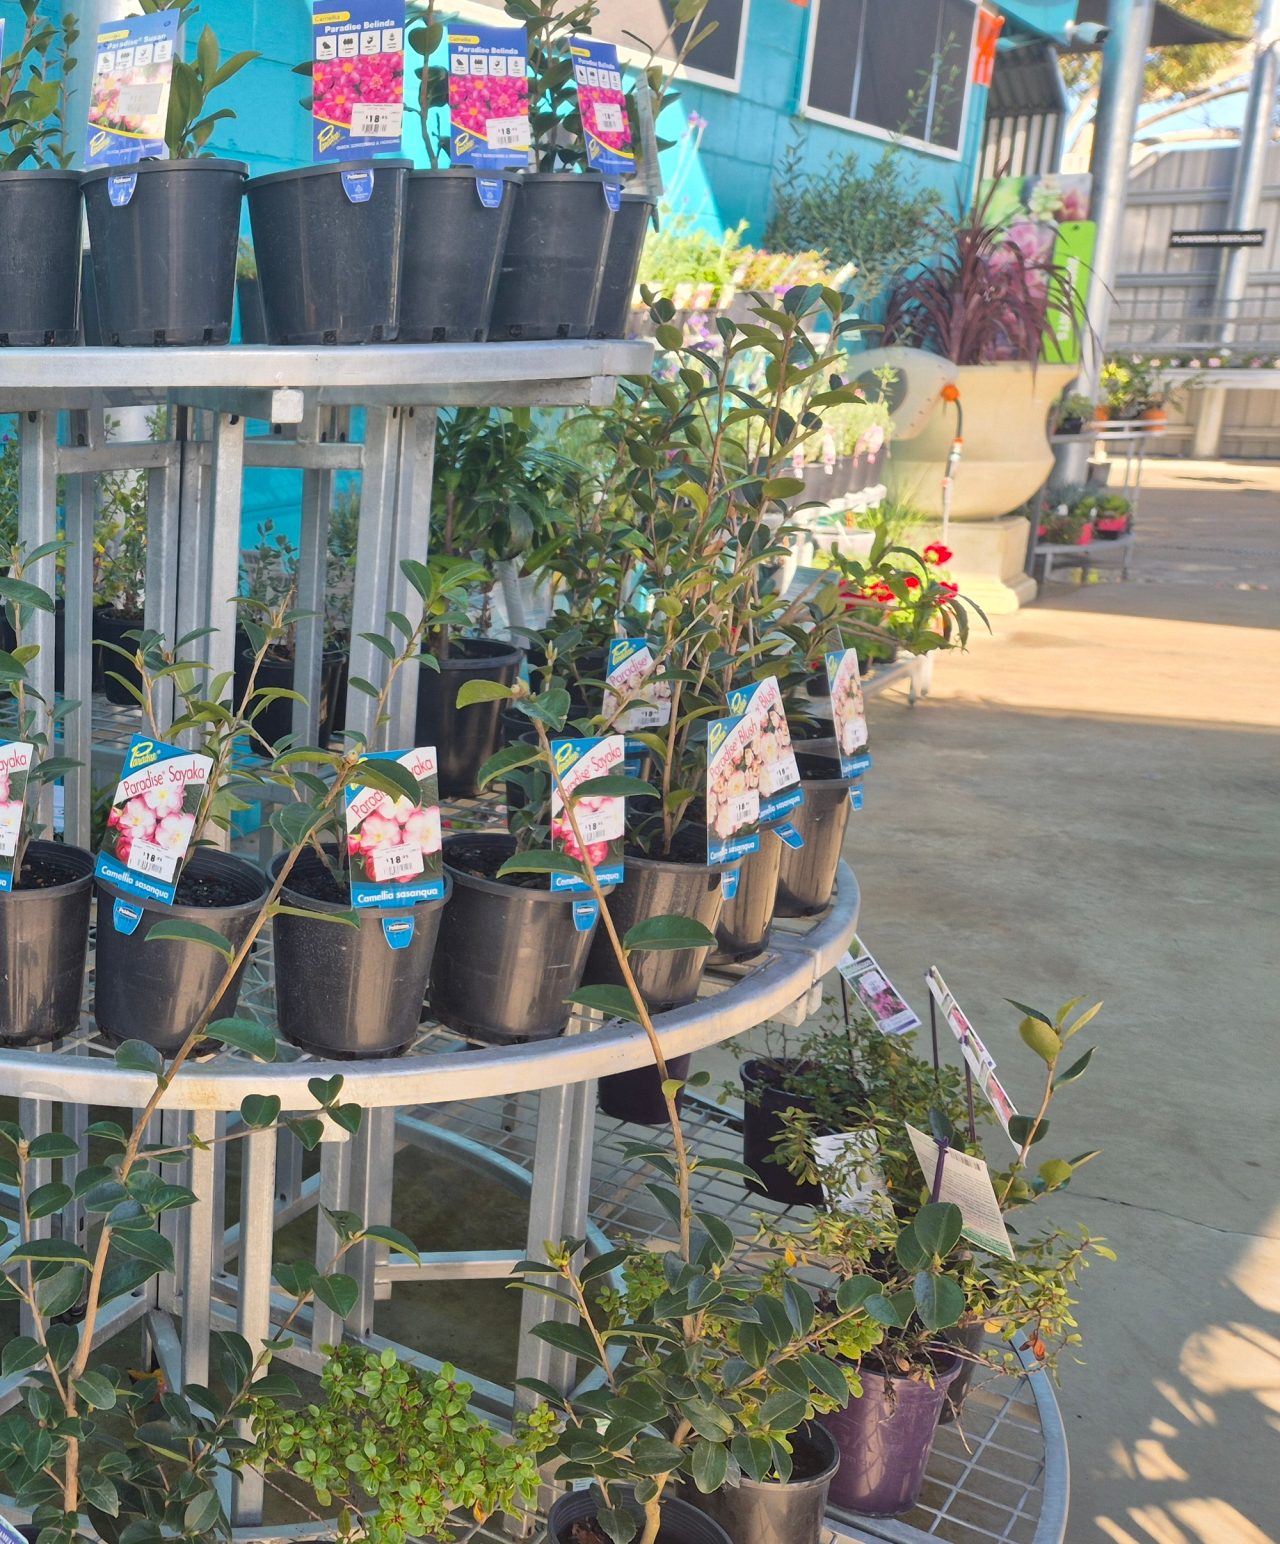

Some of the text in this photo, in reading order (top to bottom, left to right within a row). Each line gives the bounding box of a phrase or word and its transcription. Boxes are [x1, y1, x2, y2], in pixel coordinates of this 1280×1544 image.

[324, 19, 395, 33] Paradise Belinda
[144, 34, 167, 43] Susan
[458, 45, 519, 55] Paradise Belinda
[738, 718, 757, 744] Blush
[591, 743, 622, 775] Sayaka
[168, 760, 205, 783] Sayaka
[101, 865, 169, 900] Camellia sasanqua
[357, 886, 438, 904] Camellia sasanqua
